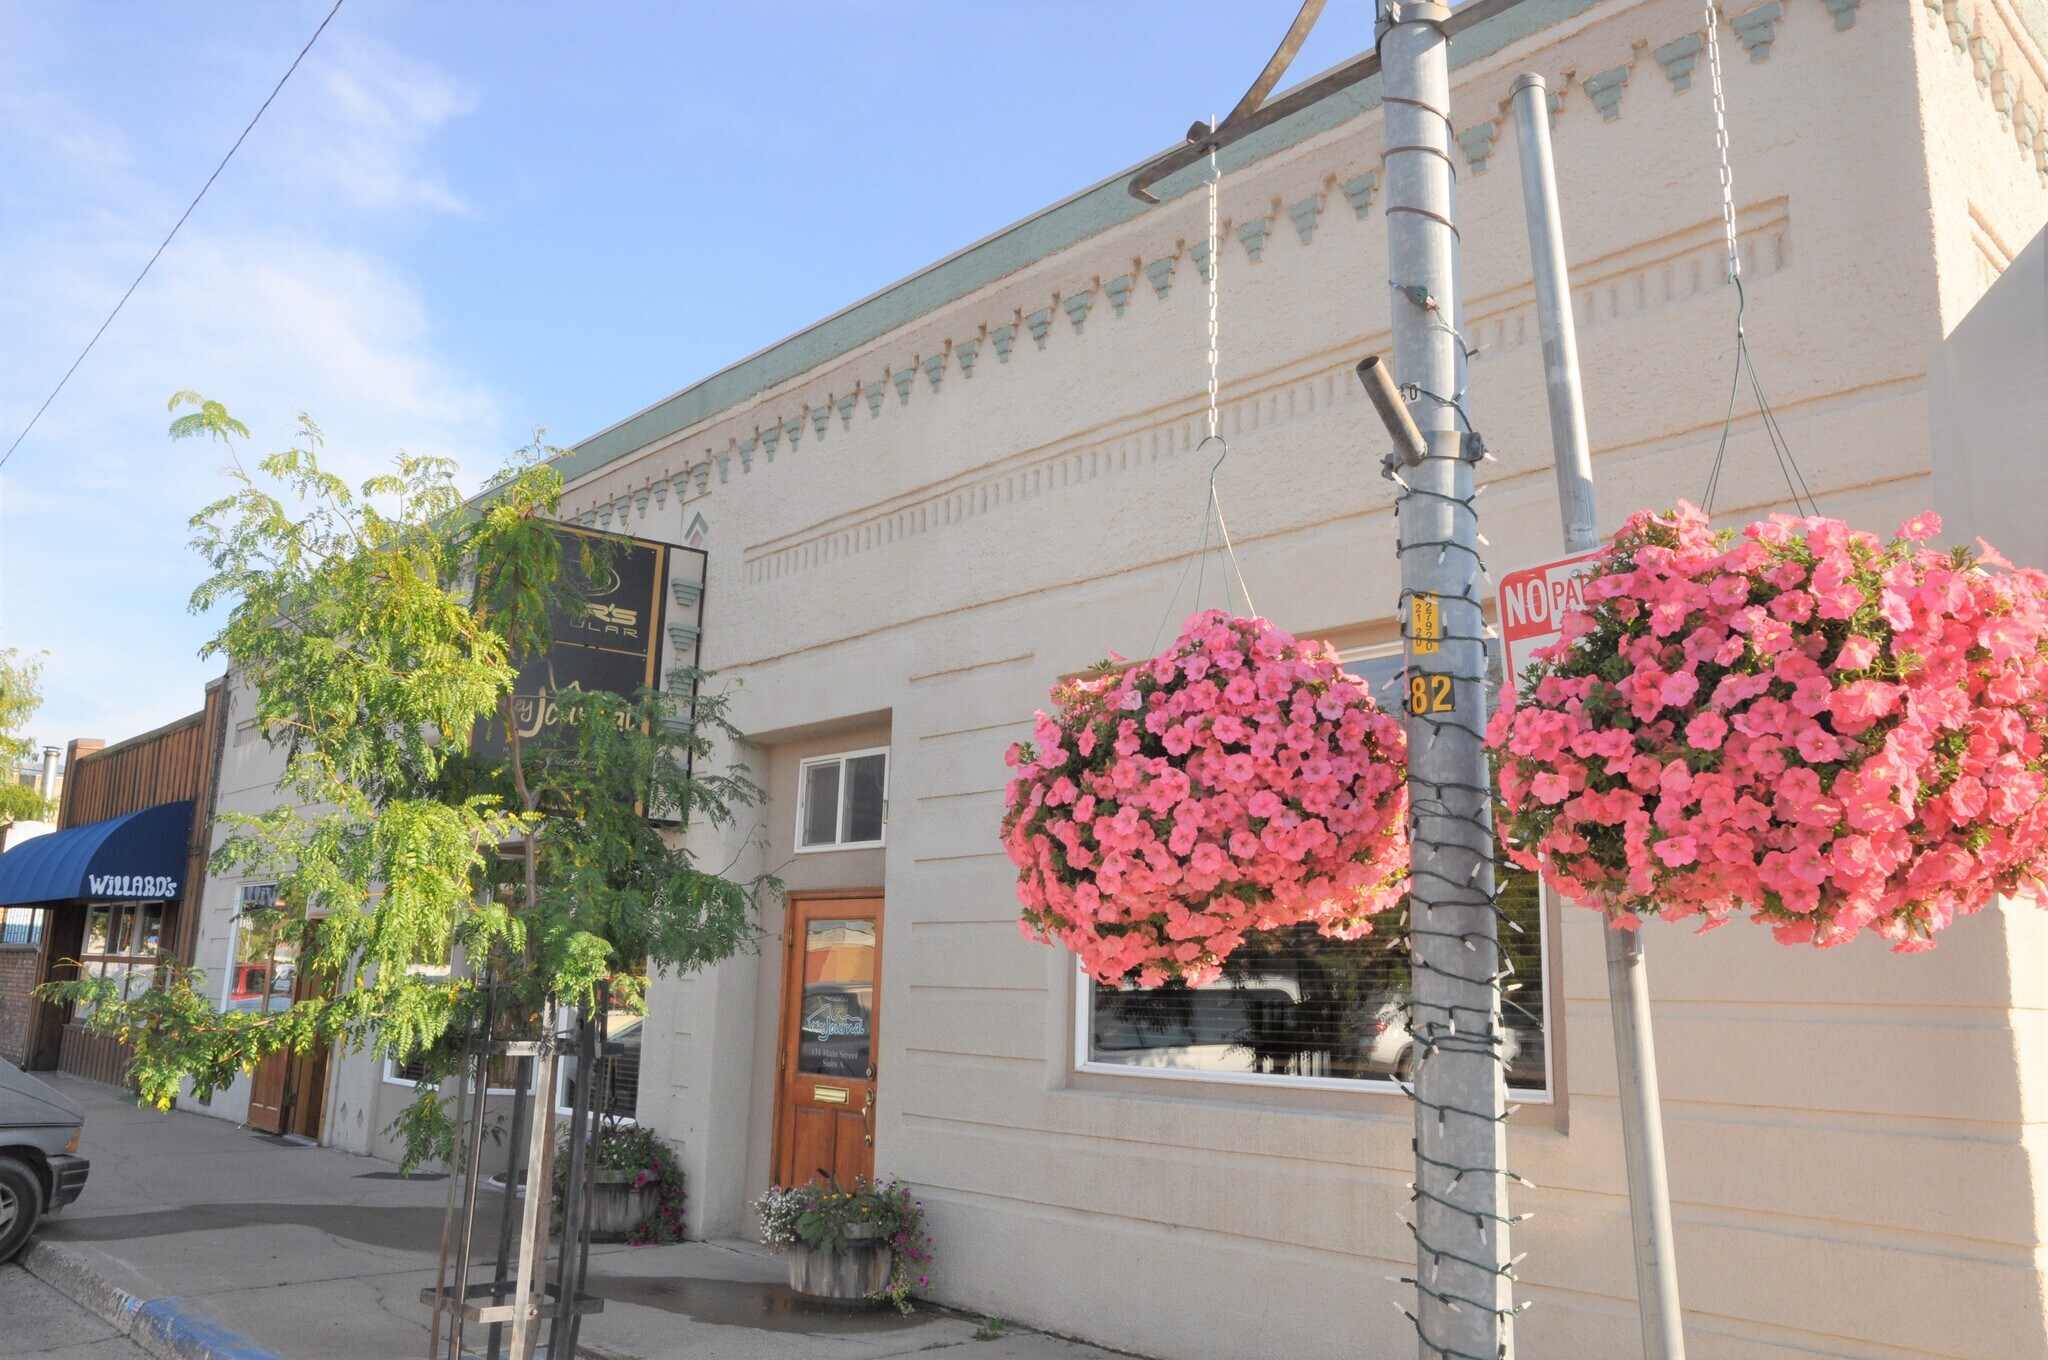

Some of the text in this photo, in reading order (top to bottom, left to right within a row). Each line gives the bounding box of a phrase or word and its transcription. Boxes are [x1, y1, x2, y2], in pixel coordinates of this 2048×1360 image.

[1504, 578, 1548, 628] NO
[1411, 674, 1453, 714] 82
[818, 1016, 865, 1041] Journal
[810, 1047, 858, 1060] 331 Main Street
[822, 1058, 839, 1068] Suite
